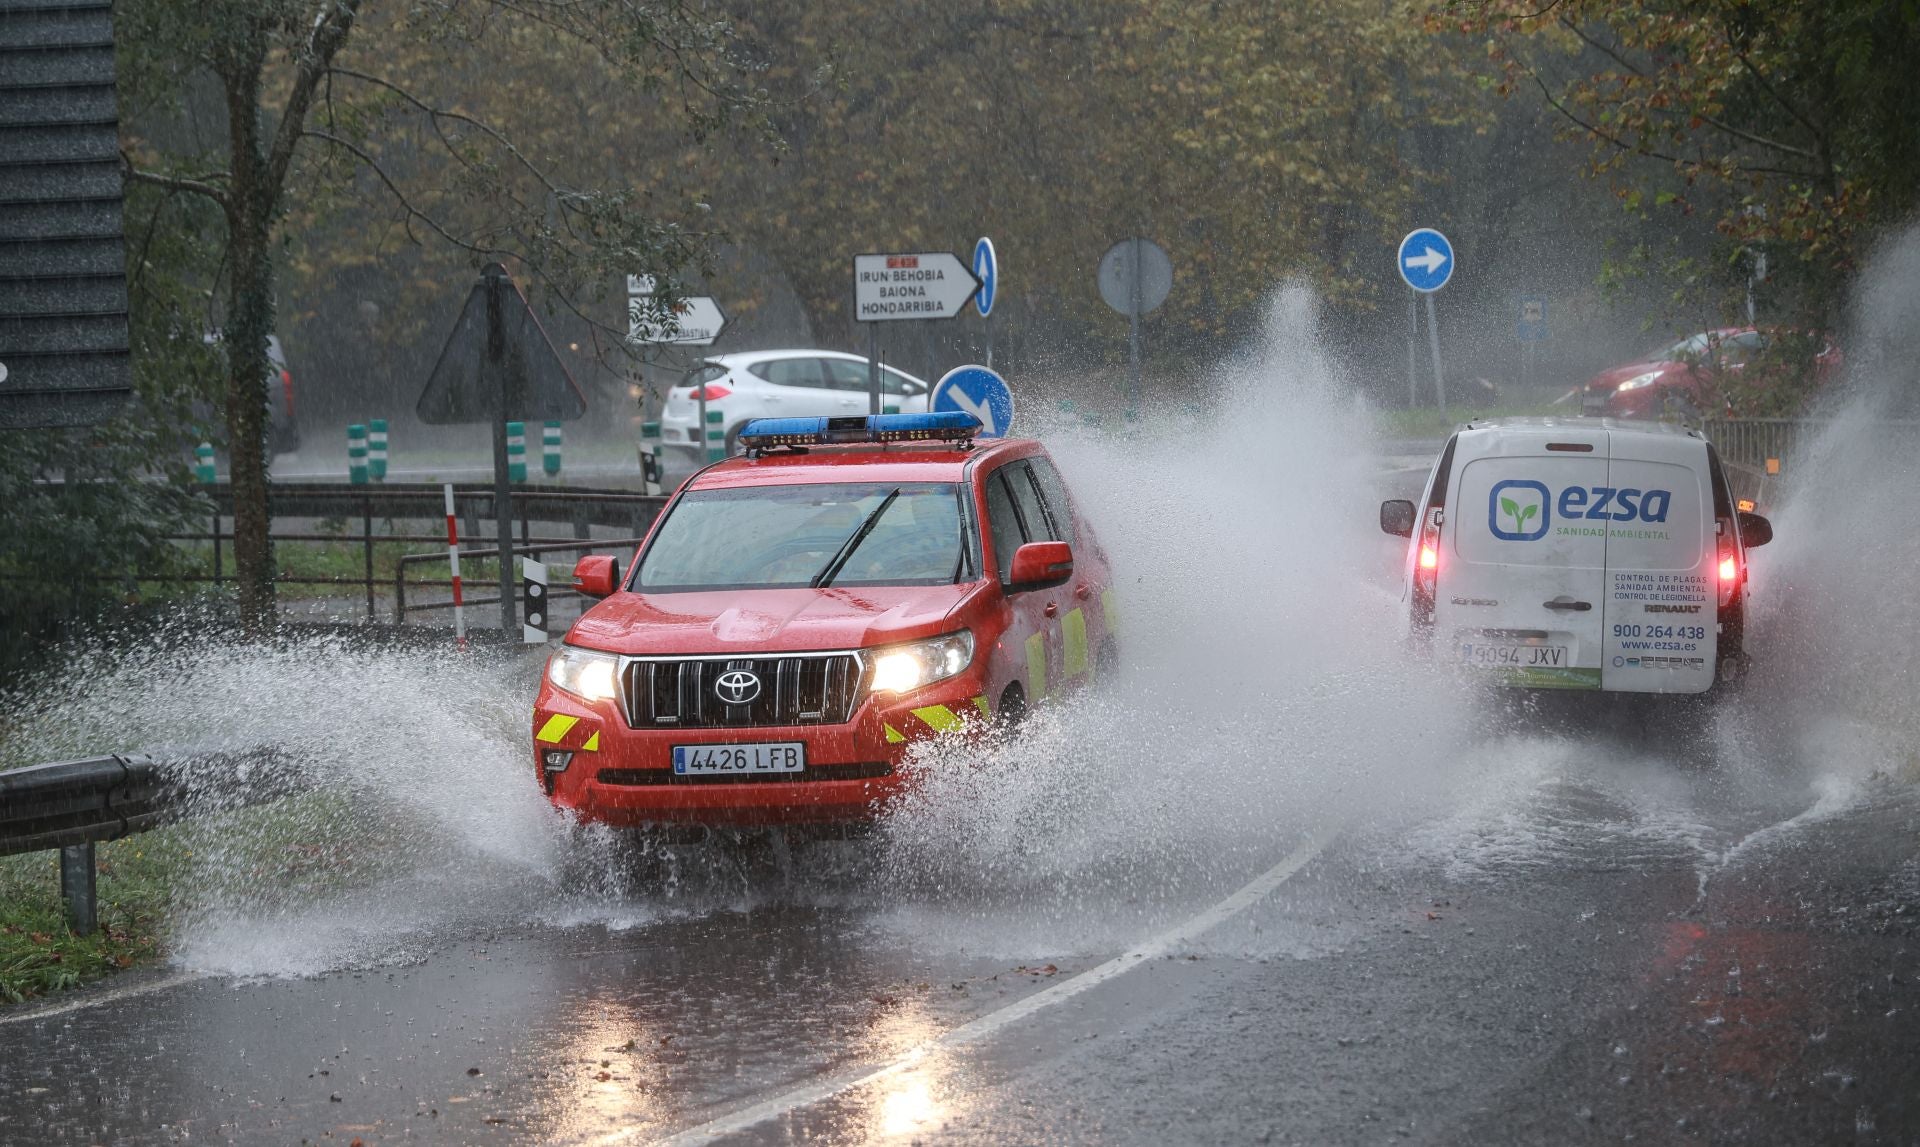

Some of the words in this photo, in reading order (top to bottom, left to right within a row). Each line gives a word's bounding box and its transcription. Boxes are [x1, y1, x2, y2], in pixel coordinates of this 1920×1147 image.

[879, 286, 926, 298] BAIONA
[862, 301, 944, 314] HONDARRIBIA
[1557, 486, 1672, 523] ezsa
[1556, 527, 1605, 537] SANIDAD
[1609, 530, 1671, 541] AMBIENTAL
[1615, 574, 1655, 582] CONTROL
[1660, 575, 1670, 583] DE
[1673, 575, 1707, 584] PLAGAS
[1614, 583, 1653, 591] SANIDAD
[1656, 584, 1707, 593] AMBIENTAL
[1614, 592, 1648, 601] CONTROL
[1650, 593, 1659, 601] DE
[1661, 593, 1706, 602] LEGIONELLA
[1644, 604, 1701, 614] RENAULT
[1613, 624, 1641, 638] 900
[1646, 625, 1673, 639] 264
[1677, 626, 1705, 640] 438
[1620, 641, 1697, 651] www.ezsa.es
[1475, 646, 1519, 663] 9094
[1527, 648, 1561, 665] JXV
[690, 749, 747, 770] 4426
[755, 747, 798, 769] LFB
